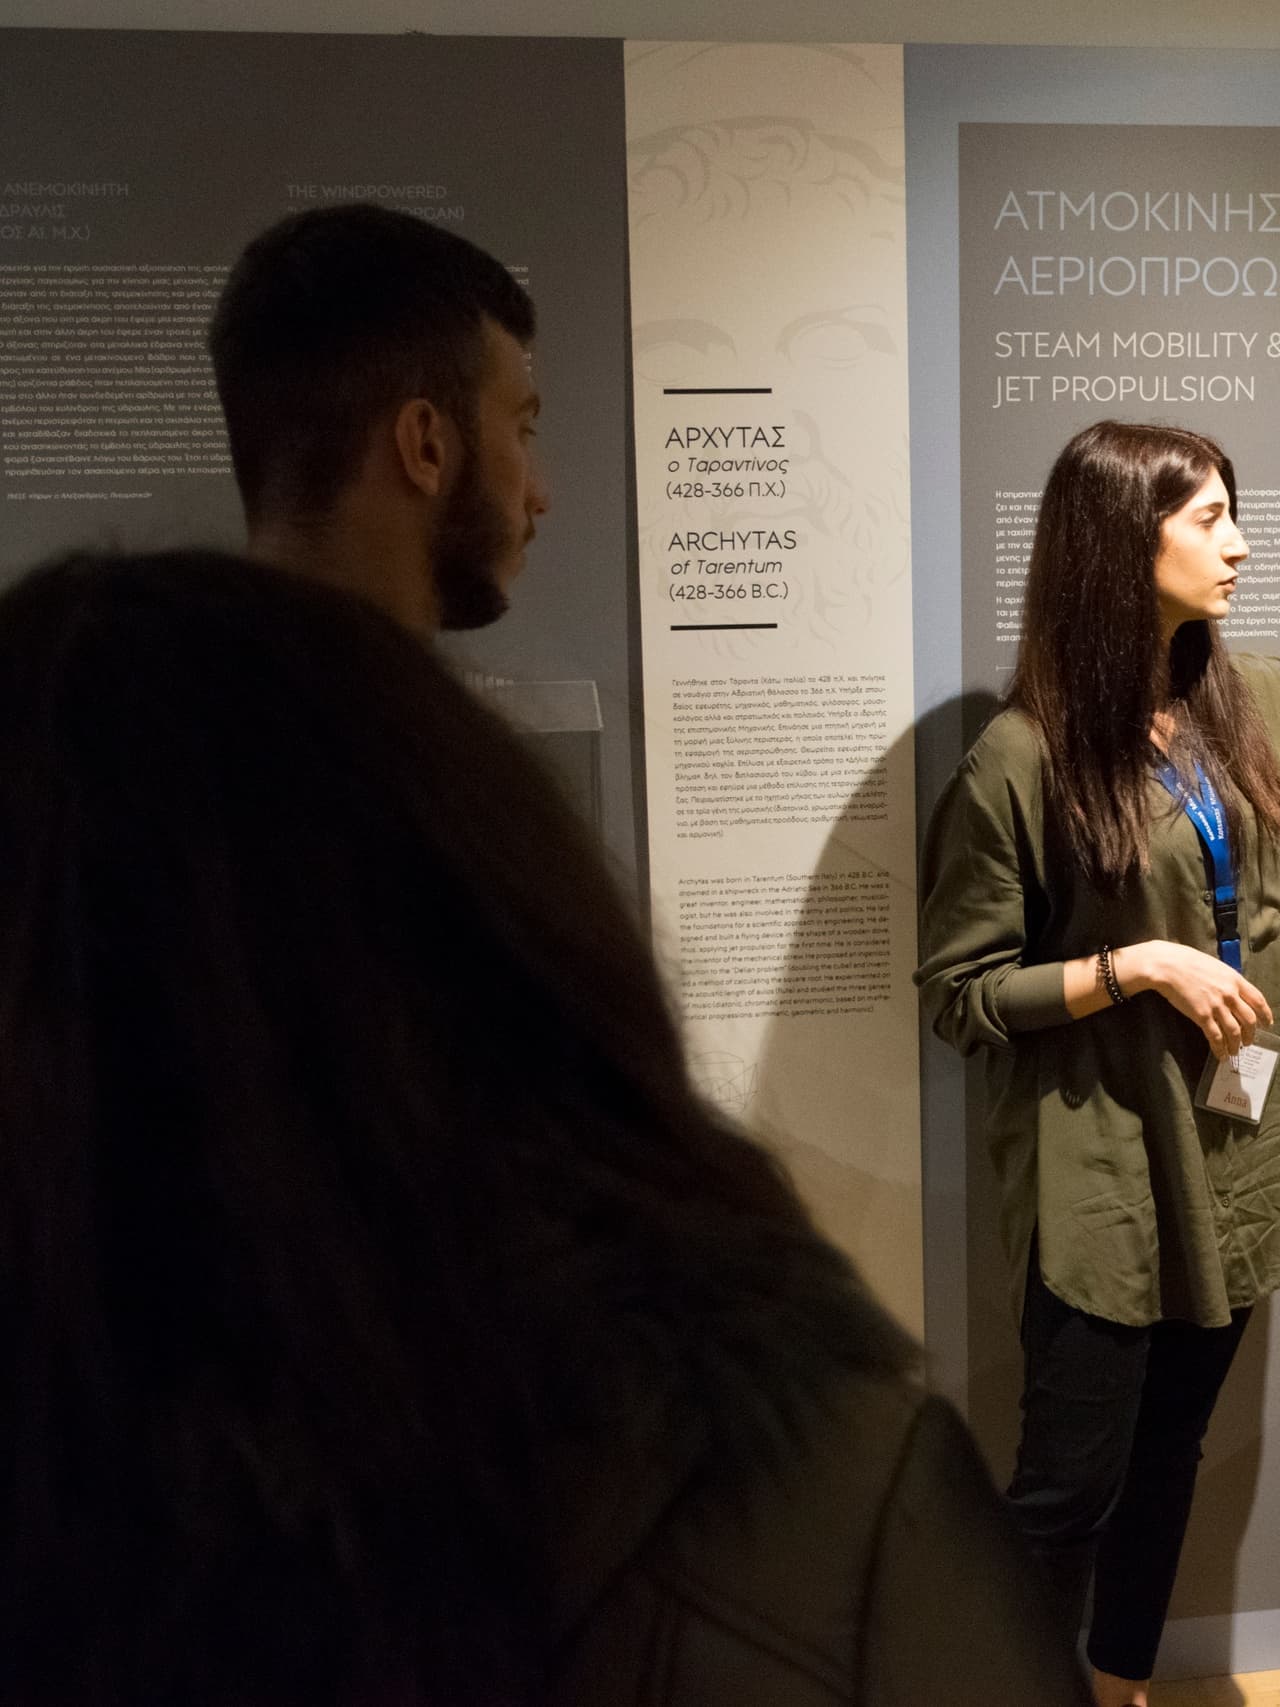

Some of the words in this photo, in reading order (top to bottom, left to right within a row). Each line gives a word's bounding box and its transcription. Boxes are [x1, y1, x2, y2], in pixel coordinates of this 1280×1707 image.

[288, 185, 318, 198] THE
[321, 184, 447, 200] WINDPOWERED
[0, 204, 65, 216] ΔΡΑΥΛΙΣ
[994, 331, 1101, 358] STEAM
[1113, 331, 1258, 359] MOBILITY
[993, 376, 1041, 408] JET
[1052, 376, 1255, 402] PROPULSION
[665, 426, 785, 449] ΑΡΧΥΤΑΣ
[668, 461, 679, 472] ο
[688, 456, 789, 475] Ταραντίνος
[666, 481, 744, 500] (428-366
[749, 480, 786, 499] Π.Χ.)
[668, 530, 797, 551] ARCHYTAS
[671, 560, 691, 574] of
[697, 559, 783, 574] Tarentum
[669, 584, 747, 602] (428-366
[752, 581, 789, 600] B.C.)
[1224, 1092, 1247, 1108] Anna
